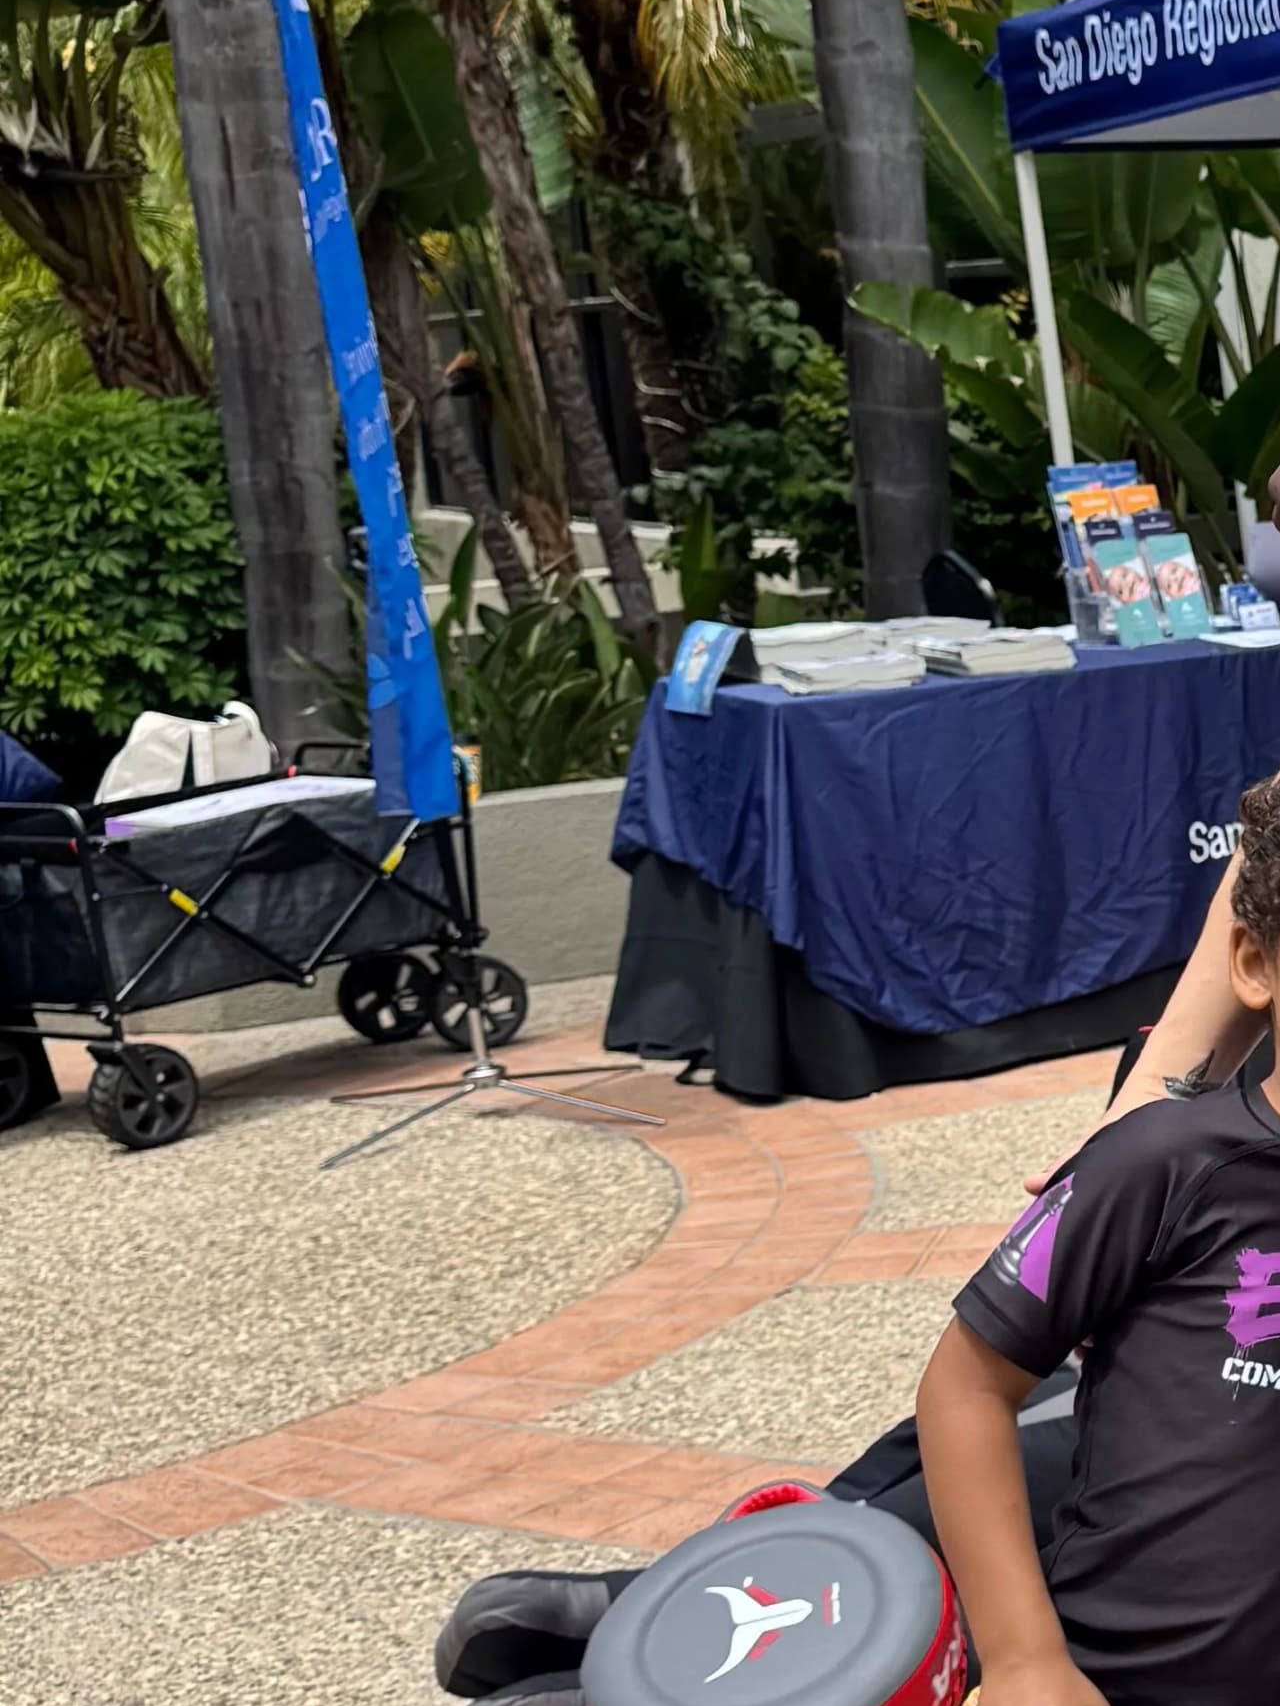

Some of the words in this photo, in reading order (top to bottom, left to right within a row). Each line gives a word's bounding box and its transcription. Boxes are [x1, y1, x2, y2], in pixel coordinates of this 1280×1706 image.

[1035, 28, 1082, 95] San
[1084, 10, 1158, 85] Diego
[1188, 821, 1244, 864] San
